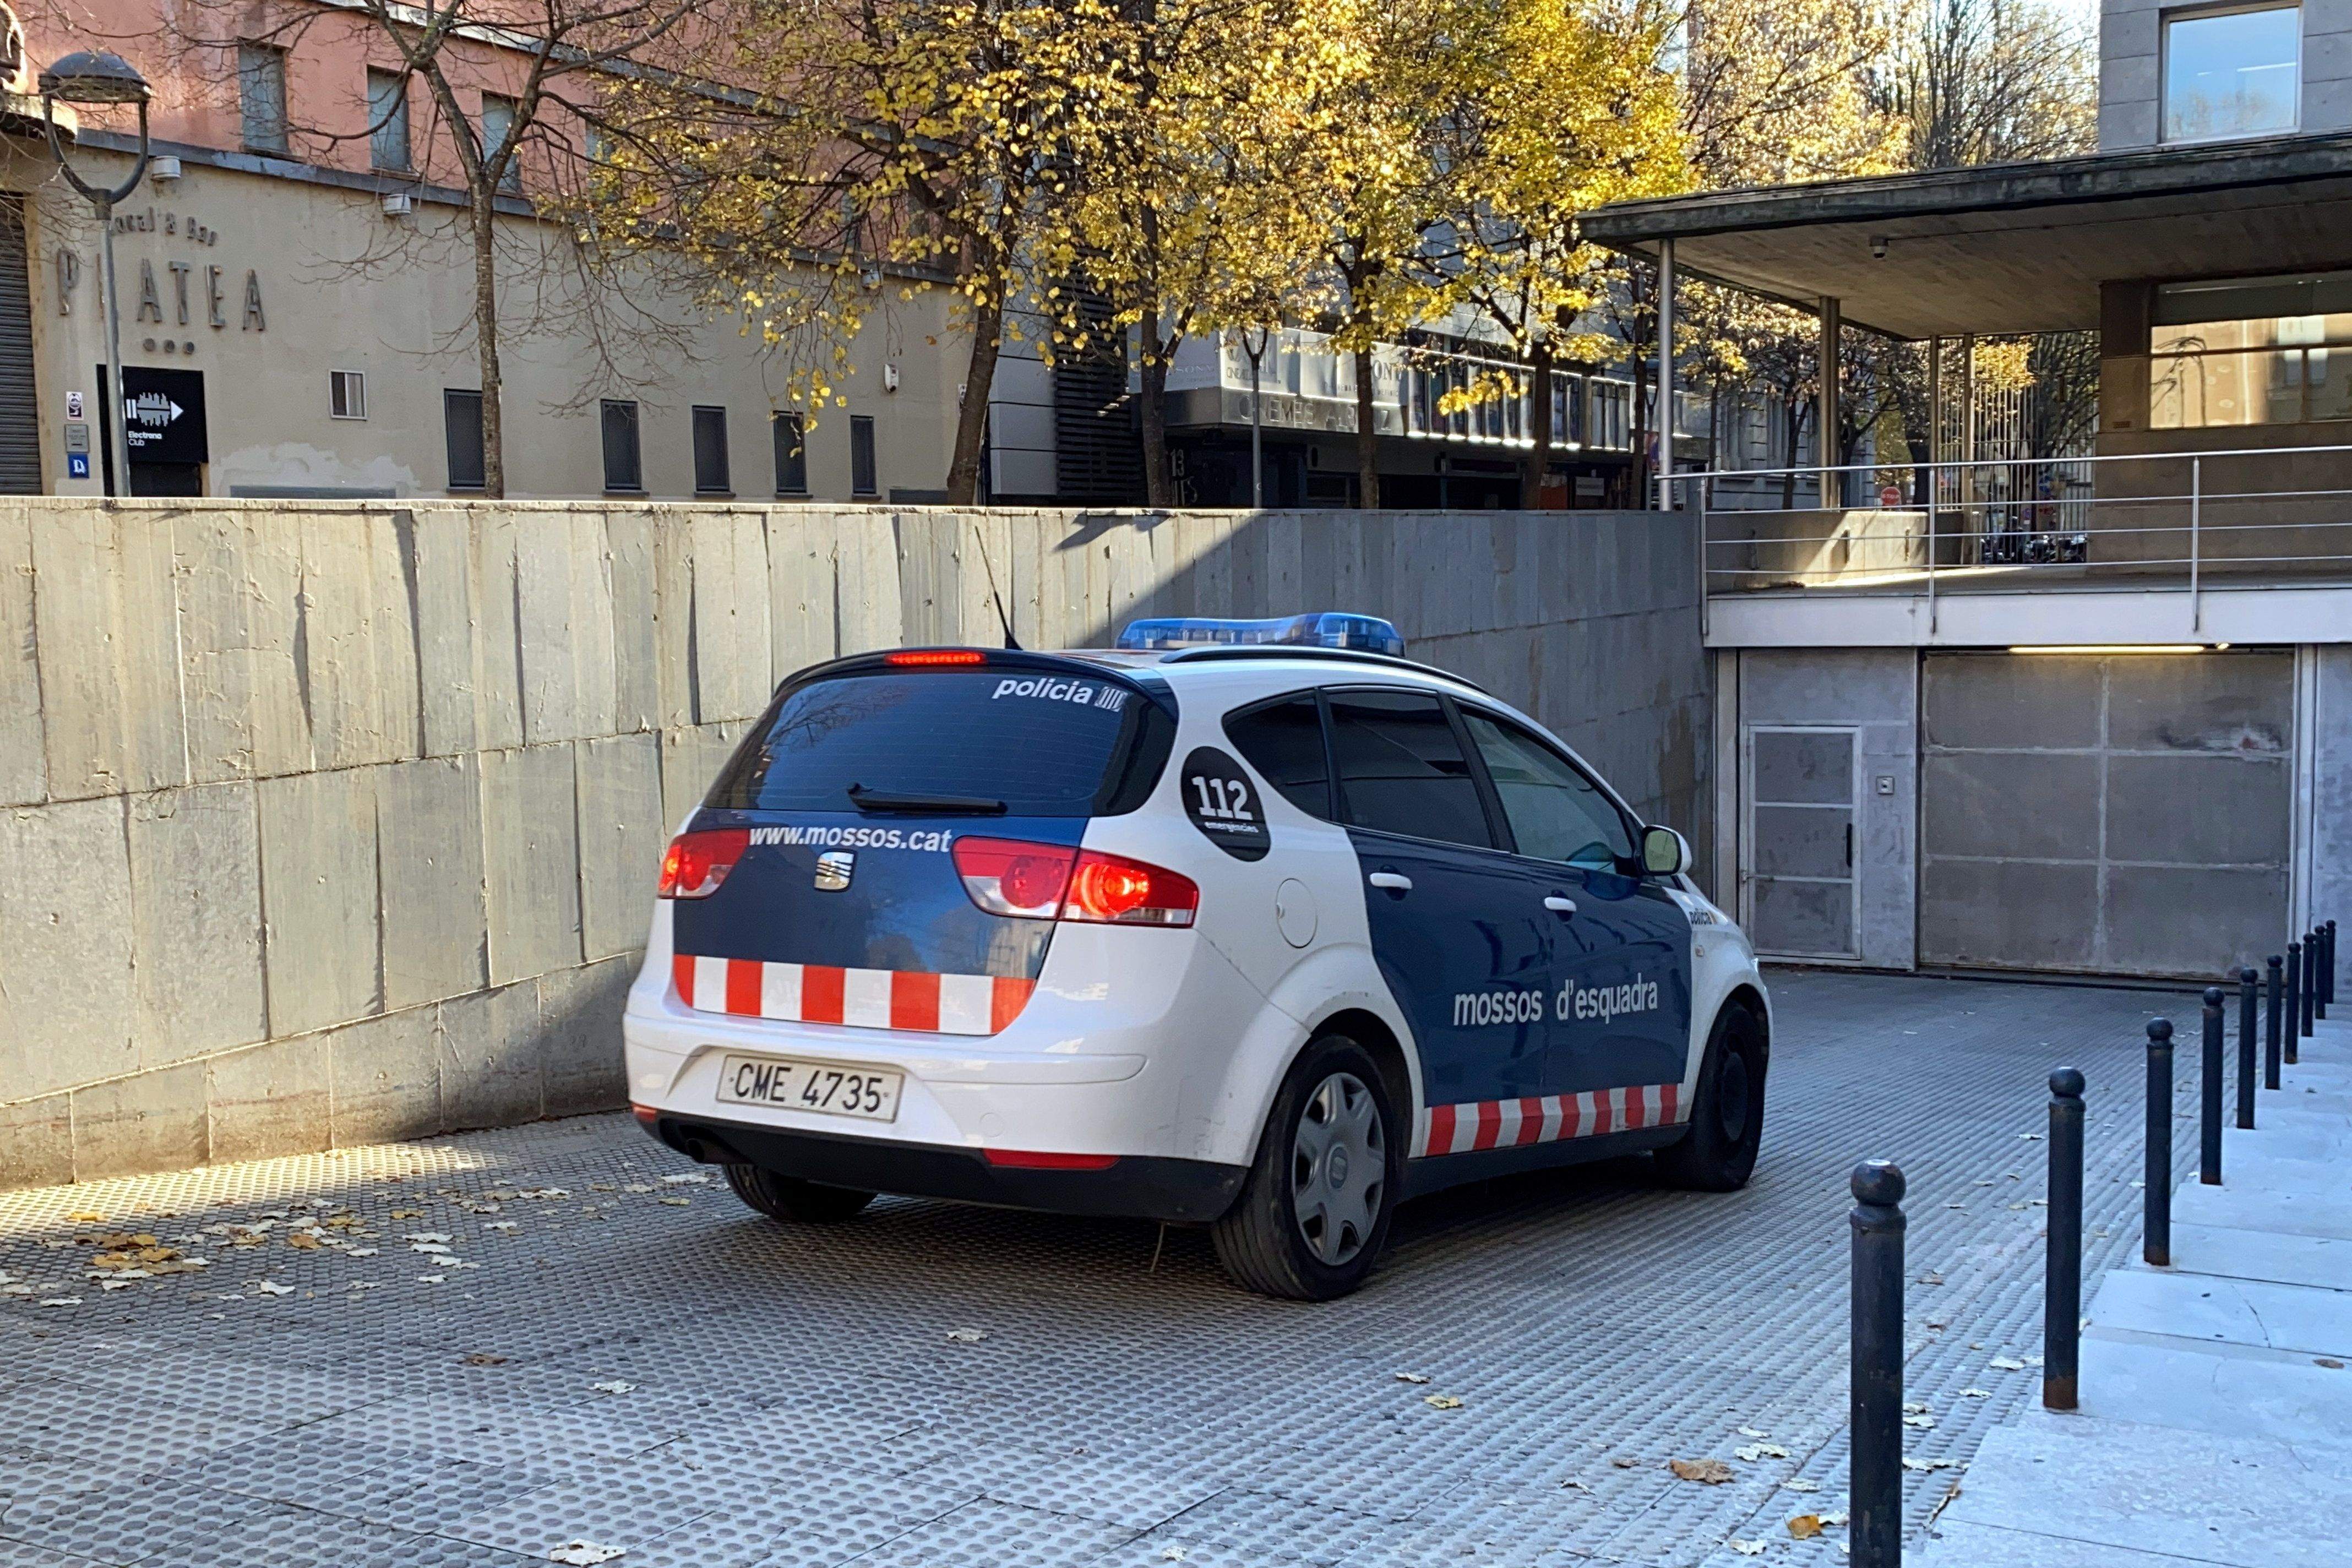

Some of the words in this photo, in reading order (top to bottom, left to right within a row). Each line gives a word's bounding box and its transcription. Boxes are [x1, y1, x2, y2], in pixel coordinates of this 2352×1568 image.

[991, 677, 1093, 704] policia
[1191, 776, 1254, 820] 112
[748, 826, 952, 853] www.mossos.cat
[1453, 990, 1542, 1026] mossos
[1556, 972, 1658, 1024] d'esquadra
[736, 1062, 792, 1102] CME
[802, 1070, 884, 1113] 4735
